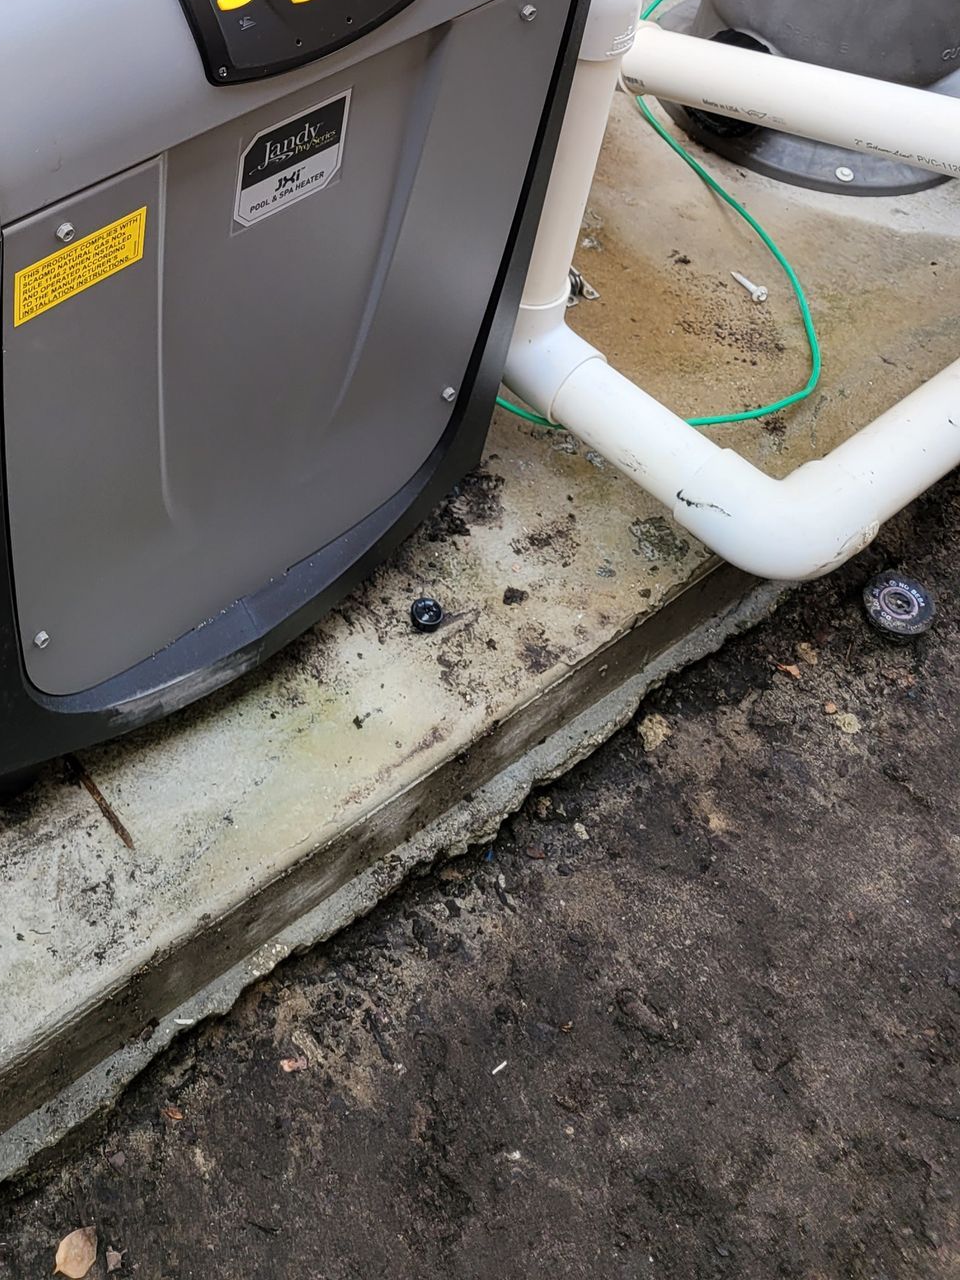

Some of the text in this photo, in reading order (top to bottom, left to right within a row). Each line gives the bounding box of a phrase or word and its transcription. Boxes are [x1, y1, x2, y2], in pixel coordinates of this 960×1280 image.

[258, 122, 321, 170] Jandy
[249, 199, 270, 213] POOL
[278, 186, 294, 199] SPA
[295, 171, 325, 191] HEATER
[22, 218, 138, 280] THIS PRODUCT COMPLIES WITH
[22, 267, 56, 288] SCAQMD
[57, 248, 91, 269] NATURAL
[93, 239, 109, 250] GAS
[22, 281, 42, 295] RULE
[68, 256, 91, 270] WHEN
[92, 234, 132, 258] INSTALLED
[22, 244, 126, 302] AND OPERATED ACCORDING
[22, 254, 118, 309] TO THE MANUFACTURER'S
[22, 255, 128, 316] INSTALLATION INSTRUCTIONS
